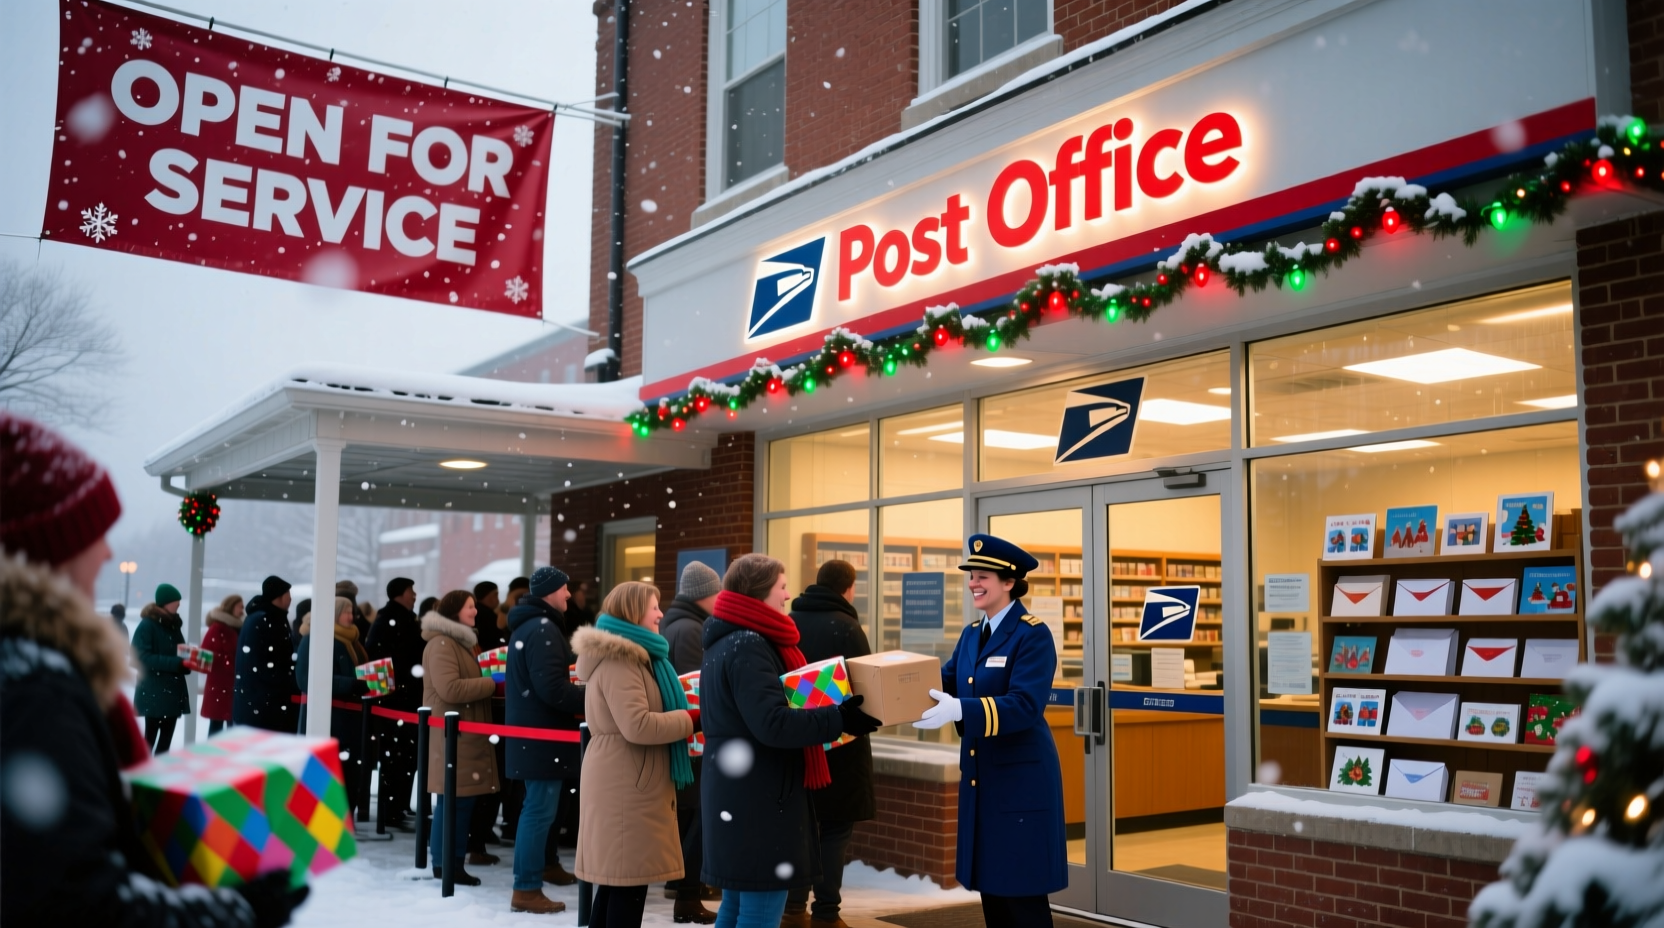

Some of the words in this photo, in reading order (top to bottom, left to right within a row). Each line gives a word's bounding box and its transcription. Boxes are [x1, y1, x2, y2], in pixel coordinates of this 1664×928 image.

[111, 59, 344, 165] OPEN
[368, 114, 514, 199] FOR
[144, 148, 481, 266] SERVICE
[838, 193, 971, 301] Post
[986, 112, 1242, 248] Office
